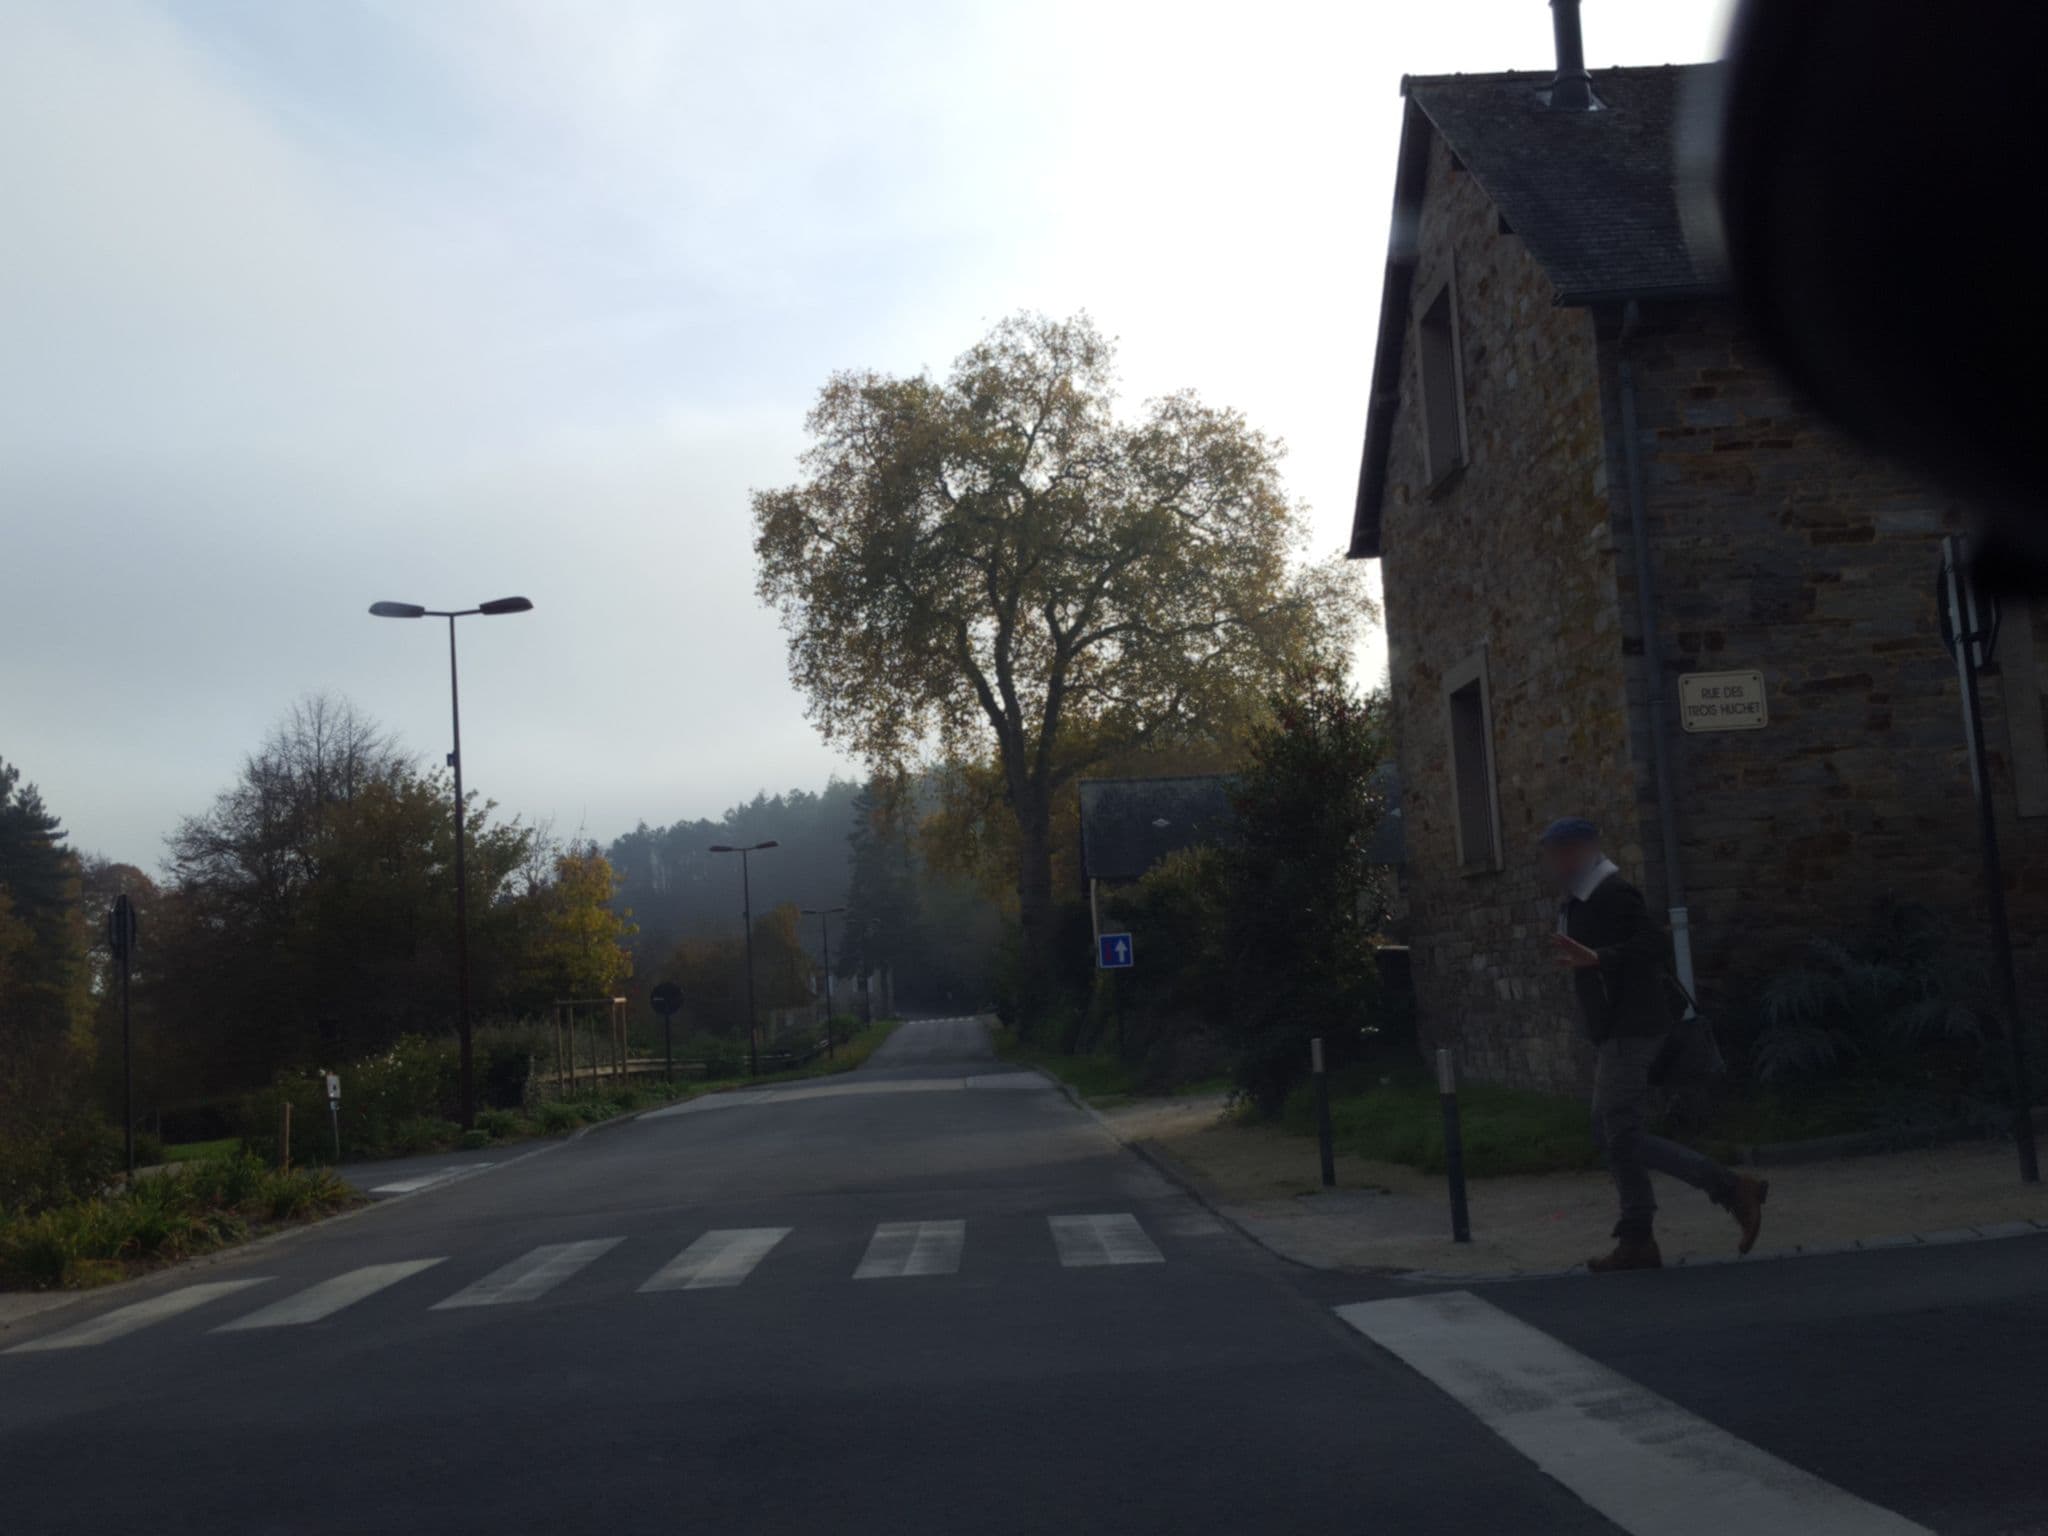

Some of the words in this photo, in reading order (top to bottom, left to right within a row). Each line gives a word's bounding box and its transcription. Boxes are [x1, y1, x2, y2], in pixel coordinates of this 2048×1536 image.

[1701, 687, 1720, 698] RUE
[1723, 686, 1744, 698] DES
[1688, 704, 1717, 716] TROIS
